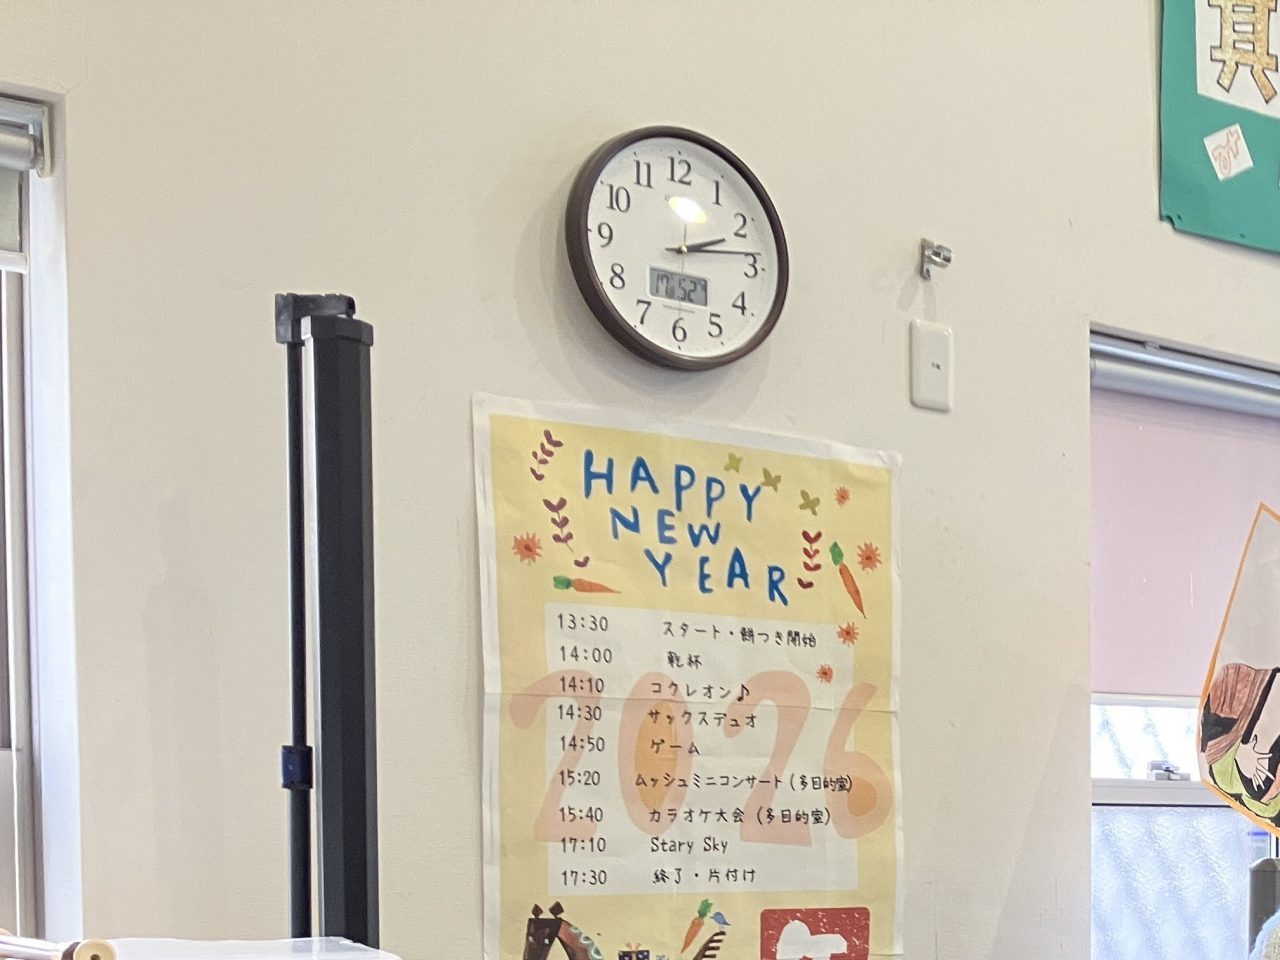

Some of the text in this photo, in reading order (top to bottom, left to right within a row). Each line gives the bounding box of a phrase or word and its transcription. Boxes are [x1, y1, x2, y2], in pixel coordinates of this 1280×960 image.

[633, 160, 654, 188] 11
[667, 156, 692, 186] 12
[606, 184, 631, 213] 10
[713, 180, 722, 206] 1
[597, 222, 614, 248] 9
[733, 212, 748, 238] 2
[609, 263, 626, 289] 8
[743, 253, 758, 279] 3
[636, 299, 652, 325] 7
[732, 291, 747, 316] 4
[672, 317, 687, 342] 6
[708, 313, 723, 338] 5
[583, 449, 762, 522] HAPPY
[610, 505, 721, 547] NEW
[644, 547, 789, 607] YEAR
[557, 613, 608, 632] 13:30
[559, 645, 703, 669] 14:00 乾杯
[559, 676, 605, 693] 14:10
[557, 704, 757, 728] 14:30 サックスデュオ
[560, 736, 701, 755] 14:50 ゲーム
[559, 770, 601, 787] 15:20
[559, 806, 604, 822] 15:40
[560, 836, 729, 854] 17:10 Stary Sky
[561, 867, 757, 886] 17:30 終了・片付け
